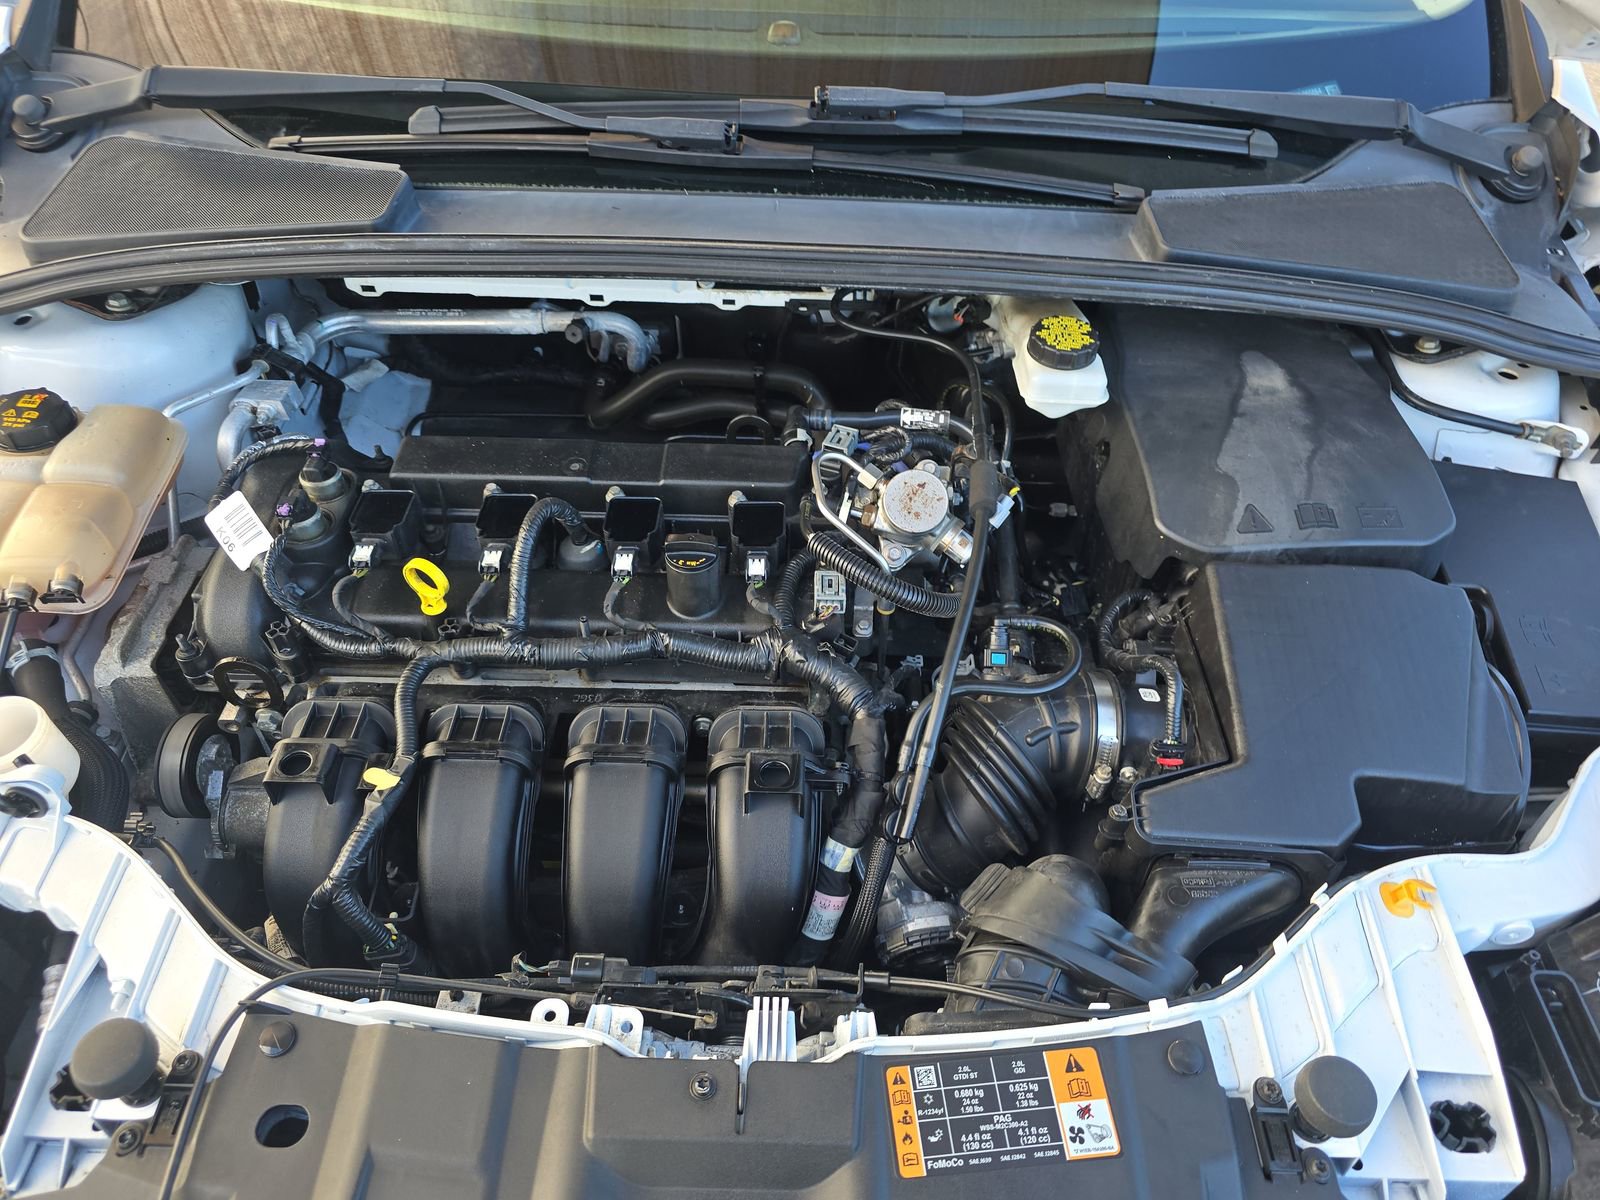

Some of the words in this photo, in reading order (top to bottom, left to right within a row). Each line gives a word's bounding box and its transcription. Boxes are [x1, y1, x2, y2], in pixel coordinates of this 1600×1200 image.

[216, 526, 236, 552] K06
[953, 1073, 969, 1081] GTDI
[1009, 1083, 1028, 1092] 0.625
[1029, 1082, 1039, 1092] kg
[974, 1088, 984, 1098] kg
[918, 1108, 944, 1116] R-1234yf
[993, 1114, 1012, 1123] PAG
[1018, 1127, 1029, 1136] 4.1
[961, 1134, 973, 1142] 4.4
[974, 1133, 980, 1141] fl
[1020, 1136, 1037, 1145] (120
[1038, 1134, 1051, 1143] cc)
[963, 1142, 980, 1152] (130
[981, 1140, 994, 1150] cc)
[927, 1158, 964, 1170] FoMoCo
